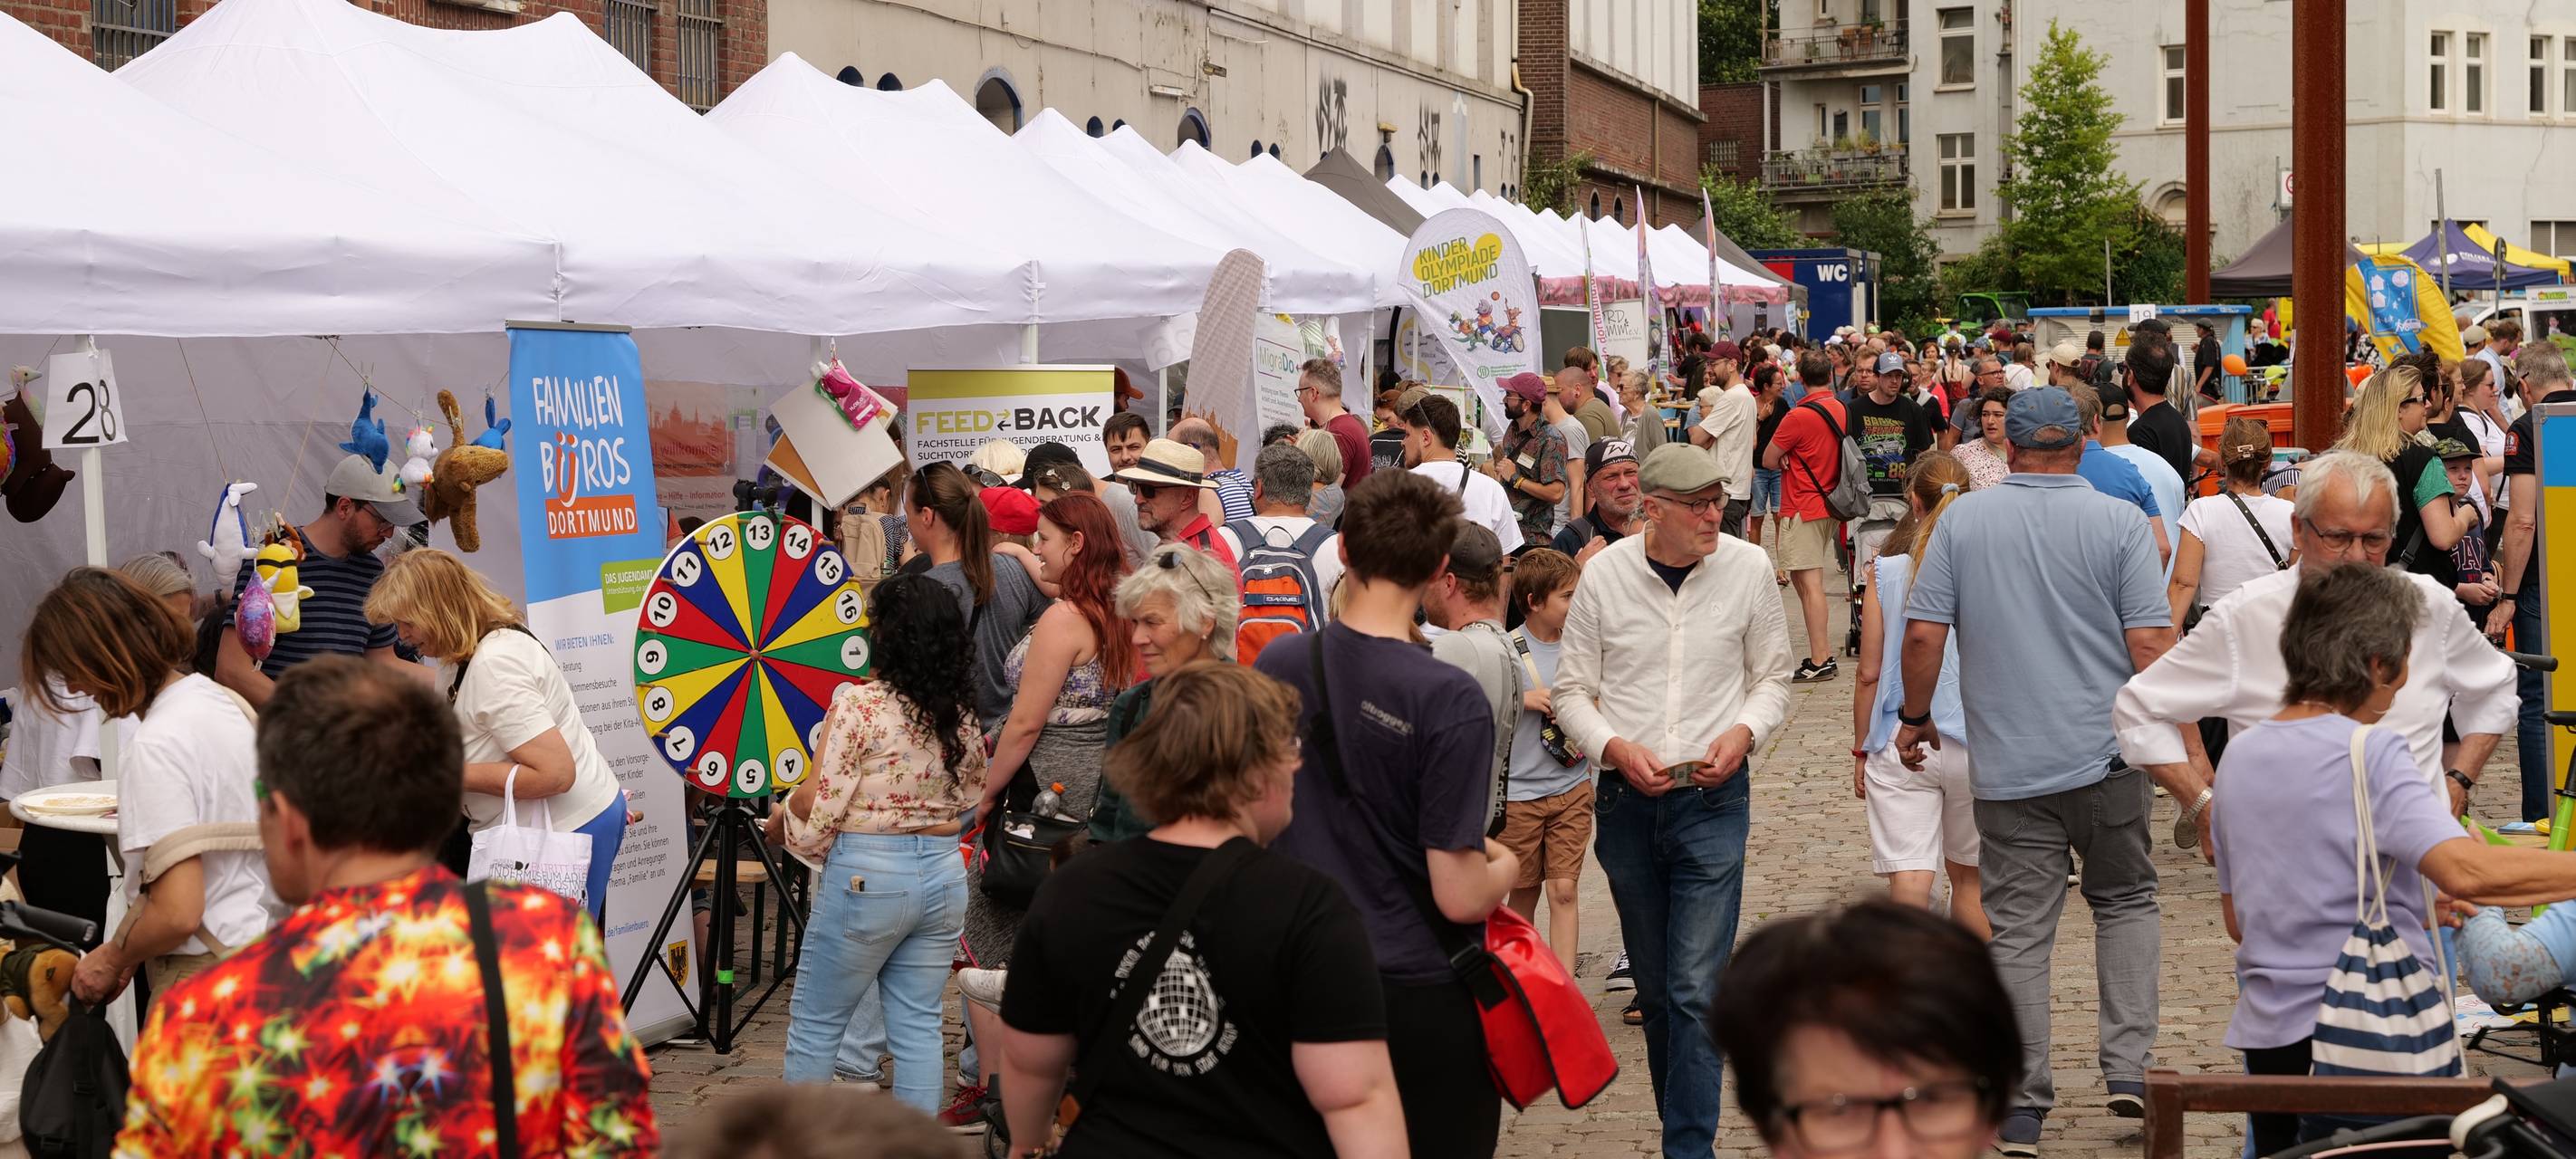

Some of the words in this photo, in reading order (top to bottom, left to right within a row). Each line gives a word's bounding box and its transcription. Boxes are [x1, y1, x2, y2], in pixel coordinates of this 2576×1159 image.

[1418, 236, 1467, 263] KINDER
[1420, 244, 1498, 282] OLYMPIADE
[1423, 263, 1498, 299] DORTMUND
[1816, 263, 1848, 283] WC
[2134, 310, 2152, 321] 19
[1260, 347, 1294, 373] MigraDo
[533, 375, 623, 430] FAMILIEN
[62, 378, 116, 445] 28
[916, 409, 995, 435] FEED
[1014, 406, 1101, 431] BACK
[918, 437, 976, 448] FACHSTELLE
[1094, 434, 1101, 442] &
[540, 431, 631, 508] BÜROS
[549, 507, 635, 535] DORTMUND
[748, 525, 770, 541] 13
[709, 532, 733, 551] 12
[788, 532, 809, 551] 14
[677, 557, 697, 580] 11
[819, 556, 840, 579] 15
[604, 573, 617, 584] DAS
[617, 569, 653, 584] JUGENDAMT
[654, 596, 671, 621] 10
[839, 594, 857, 619] 16
[555, 638, 566, 651] WIR
[567, 637, 588, 649] BIETEN
[590, 634, 615, 647] IHNEN:
[645, 650, 659, 663] 9
[848, 647, 861, 656] 1
[562, 661, 582, 673] Beratung
[601, 701, 610, 710] aus
[652, 696, 666, 712] 8
[604, 721, 612, 732] bei
[614, 722, 622, 731] der
[672, 737, 687, 752] 7
[616, 757, 626, 767] den
[626, 753, 649, 766] Vorsorge-
[784, 759, 795, 774] 4
[627, 769, 644, 780] Kinder
[706, 761, 718, 776] 6
[745, 769, 756, 784] 5
[630, 790, 646, 800] milien
[1494, 781, 1506, 818] adida
[629, 828, 637, 838] Sie
[638, 825, 648, 836] und
[625, 842, 642, 854] dürfen.
[651, 838, 669, 848] können
[627, 857, 637, 868] und
[638, 853, 667, 867] Anregungen
[657, 868, 666, 877] uns
